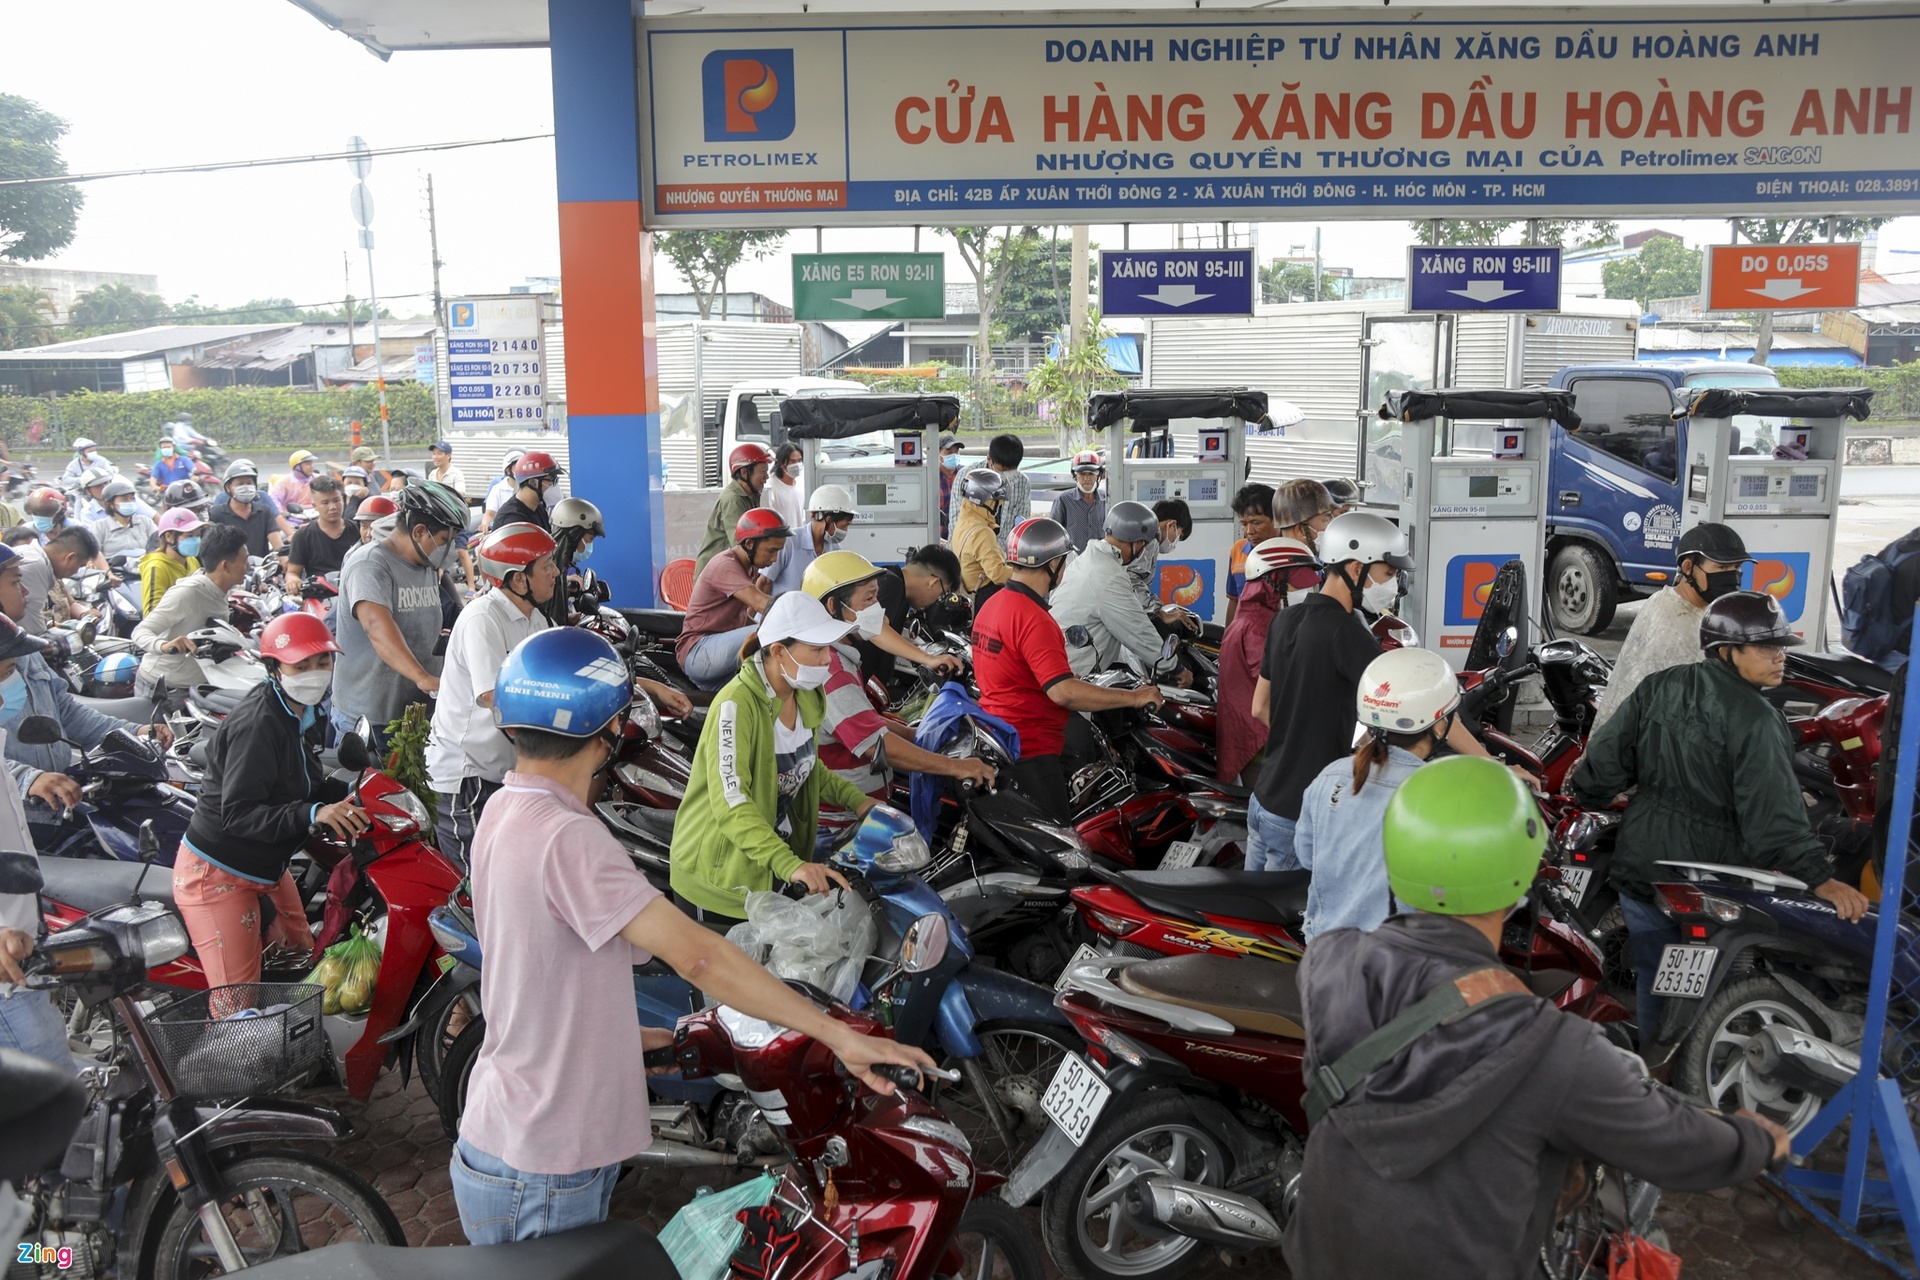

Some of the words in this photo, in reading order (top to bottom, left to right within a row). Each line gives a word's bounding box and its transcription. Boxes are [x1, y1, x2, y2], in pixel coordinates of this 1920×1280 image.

[1045, 39, 1154, 63] DOANH
[1169, 33, 1285, 68] NGHIỆP
[1299, 32, 1342, 61] TƯ
[1354, 31, 1441, 60] NHÂN
[1454, 31, 1541, 60] XĂNG
[1555, 28, 1618, 59] DẦU
[1632, 29, 1740, 59] HOÀNG
[1753, 33, 1820, 57] ANH
[894, 78, 1015, 145] CỬA
[1043, 81, 1206, 143] HÀNG
[1231, 81, 1394, 141] XĂNG
[1421, 74, 1537, 140] DẦU
[1565, 77, 1766, 138] HOÀNG
[1789, 86, 1914, 136] ANH
[683, 153, 818, 168] PETROLIMEX
[1036, 149, 1174, 176] NHƯỢNG
[1189, 145, 1302, 171] QUYỀN
[1316, 147, 1451, 168] THƯƠNG
[1466, 150, 1523, 173] MẠI
[1538, 144, 1604, 168] CỦA
[1620, 148, 1739, 167] Petrolimex
[1743, 145, 1822, 166] SAIGON
[666, 189, 715, 207] NHƯỢNG
[719, 186, 760, 204] QUYỀN
[763, 188, 813, 203] THƯƠNG
[816, 189, 839, 206] MẠI
[894, 189, 922, 206] ĐỊA
[927, 184, 959, 202] CHỈ:
[964, 188, 993, 202] 42B
[999, 183, 1020, 201] ẤP
[1026, 184, 1070, 201] XUÂN
[1075, 184, 1112, 200] THỚI
[1118, 183, 1162, 200] ĐÔNG
[1167, 186, 1177, 200] 2
[1193, 183, 1216, 199] XÃ
[1221, 182, 1265, 199] XUÂN
[1270, 182, 1307, 199] THỚI
[1312, 182, 1356, 198] ĐÔNG
[1372, 184, 1388, 198] H.
[1394, 181, 1426, 198] HÓC
[1432, 181, 1466, 198] MÔN
[1482, 184, 1506, 197] TP.
[1512, 183, 1545, 197] HCM
[1755, 178, 1793, 198] ĐIỆN
[1798, 179, 1850, 197] THOẠI:
[801, 261, 841, 282] XĂNG
[847, 264, 865, 281] E5
[870, 264, 900, 281] RON
[905, 264, 935, 281] 92-II
[1111, 257, 1158, 278] XĂNG
[1164, 260, 1198, 278] RON
[1204, 260, 1244, 278] 95-III
[1420, 253, 1466, 274] XĂNG
[1472, 256, 1506, 274] RON
[1512, 256, 1551, 274] 95-III
[1741, 255, 1769, 273] DO
[1776, 254, 1829, 276] 0,05S
[1546, 317, 1612, 335] BRIDGESTONE
[465, 341, 476, 349] RON
[492, 339, 538, 352] 21440
[493, 362, 539, 375] 20730
[495, 384, 541, 397] 22200
[522, 679, 560, 689] HONDA
[534, 689, 570, 701] MINH
[1363, 694, 1399, 708] Dongtam
[721, 719, 732, 749] NEW
[722, 754, 737, 790] STYLE
[1024, 900, 1059, 908] HONDA
[1667, 949, 1706, 970] 50-Y1
[1655, 970, 1704, 994] 253.56
[1063, 1060, 1101, 1109] 50-Y1
[1046, 1083, 1090, 1140] 332.59
